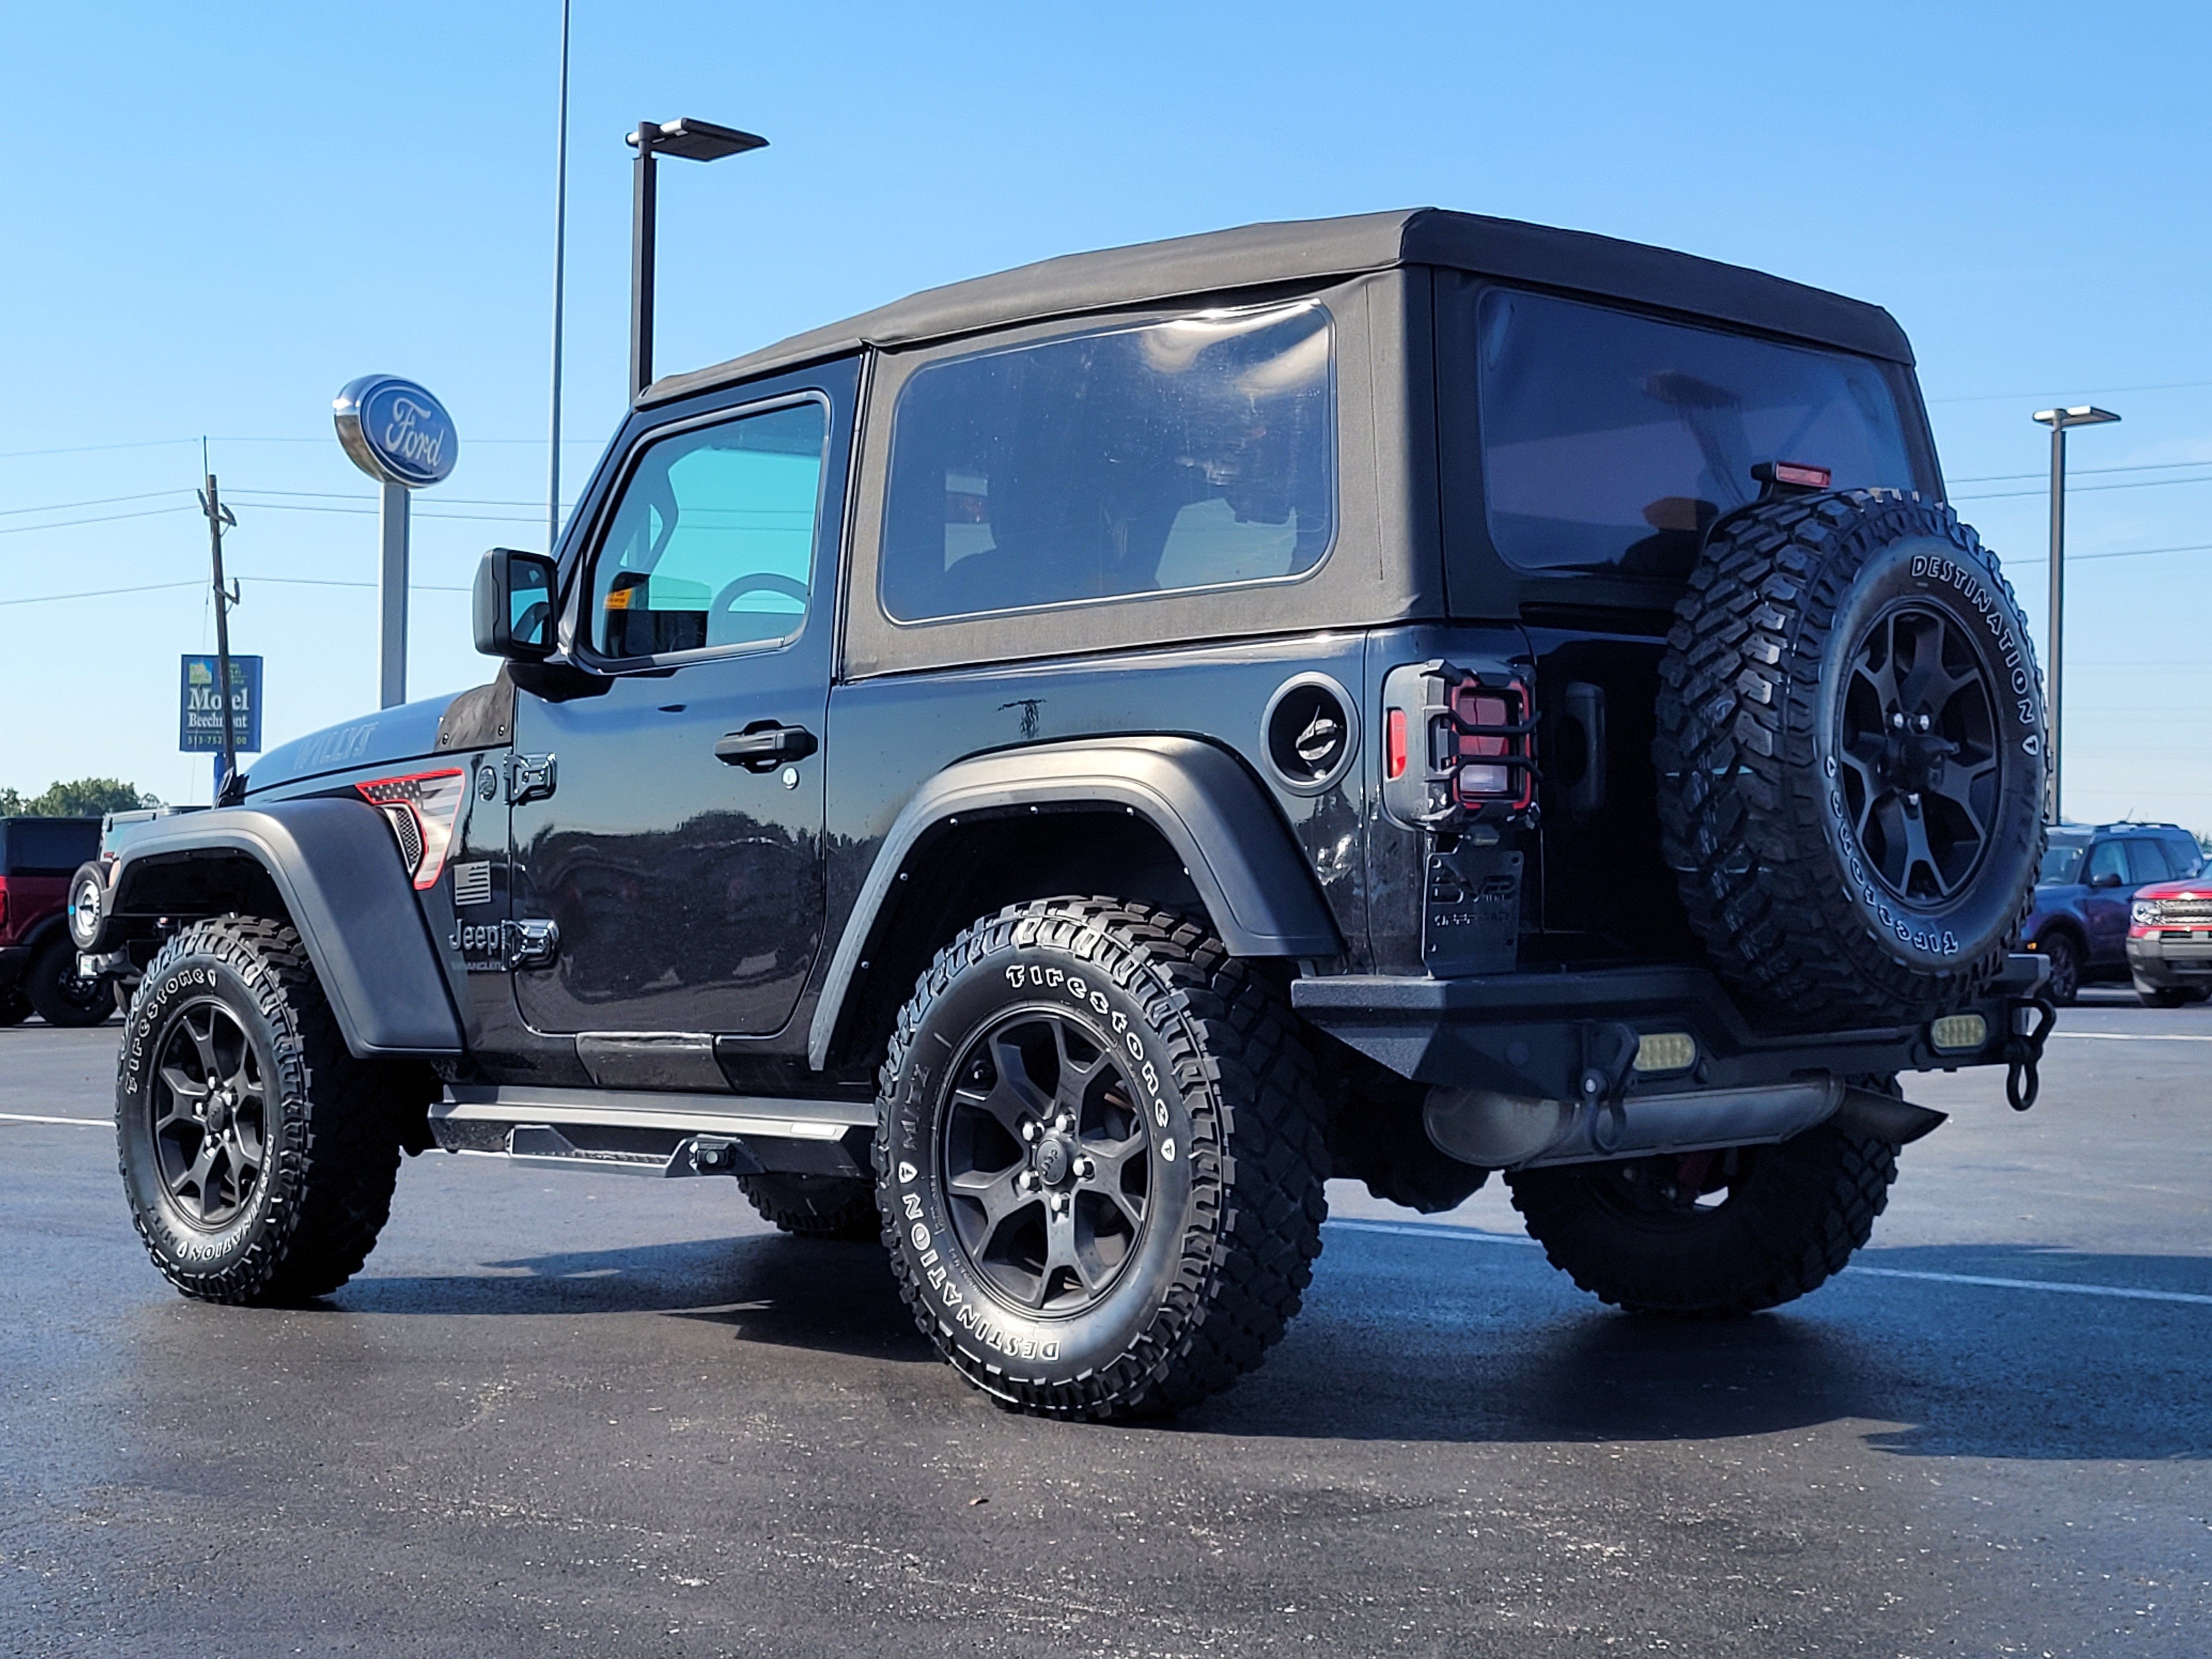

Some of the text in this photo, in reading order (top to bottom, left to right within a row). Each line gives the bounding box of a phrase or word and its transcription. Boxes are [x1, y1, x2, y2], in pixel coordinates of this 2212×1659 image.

[386, 397, 444, 467] Ford
[1911, 555, 2035, 725] DESTINATION
[187, 687, 250, 710] Moel
[188, 712, 248, 728] Beechnt
[448, 918, 500, 956] Jeep
[125, 967, 205, 1096] Firestone
[1006, 964, 1170, 1129] Firestone
[900, 1192, 1061, 1362] DESTINATION
